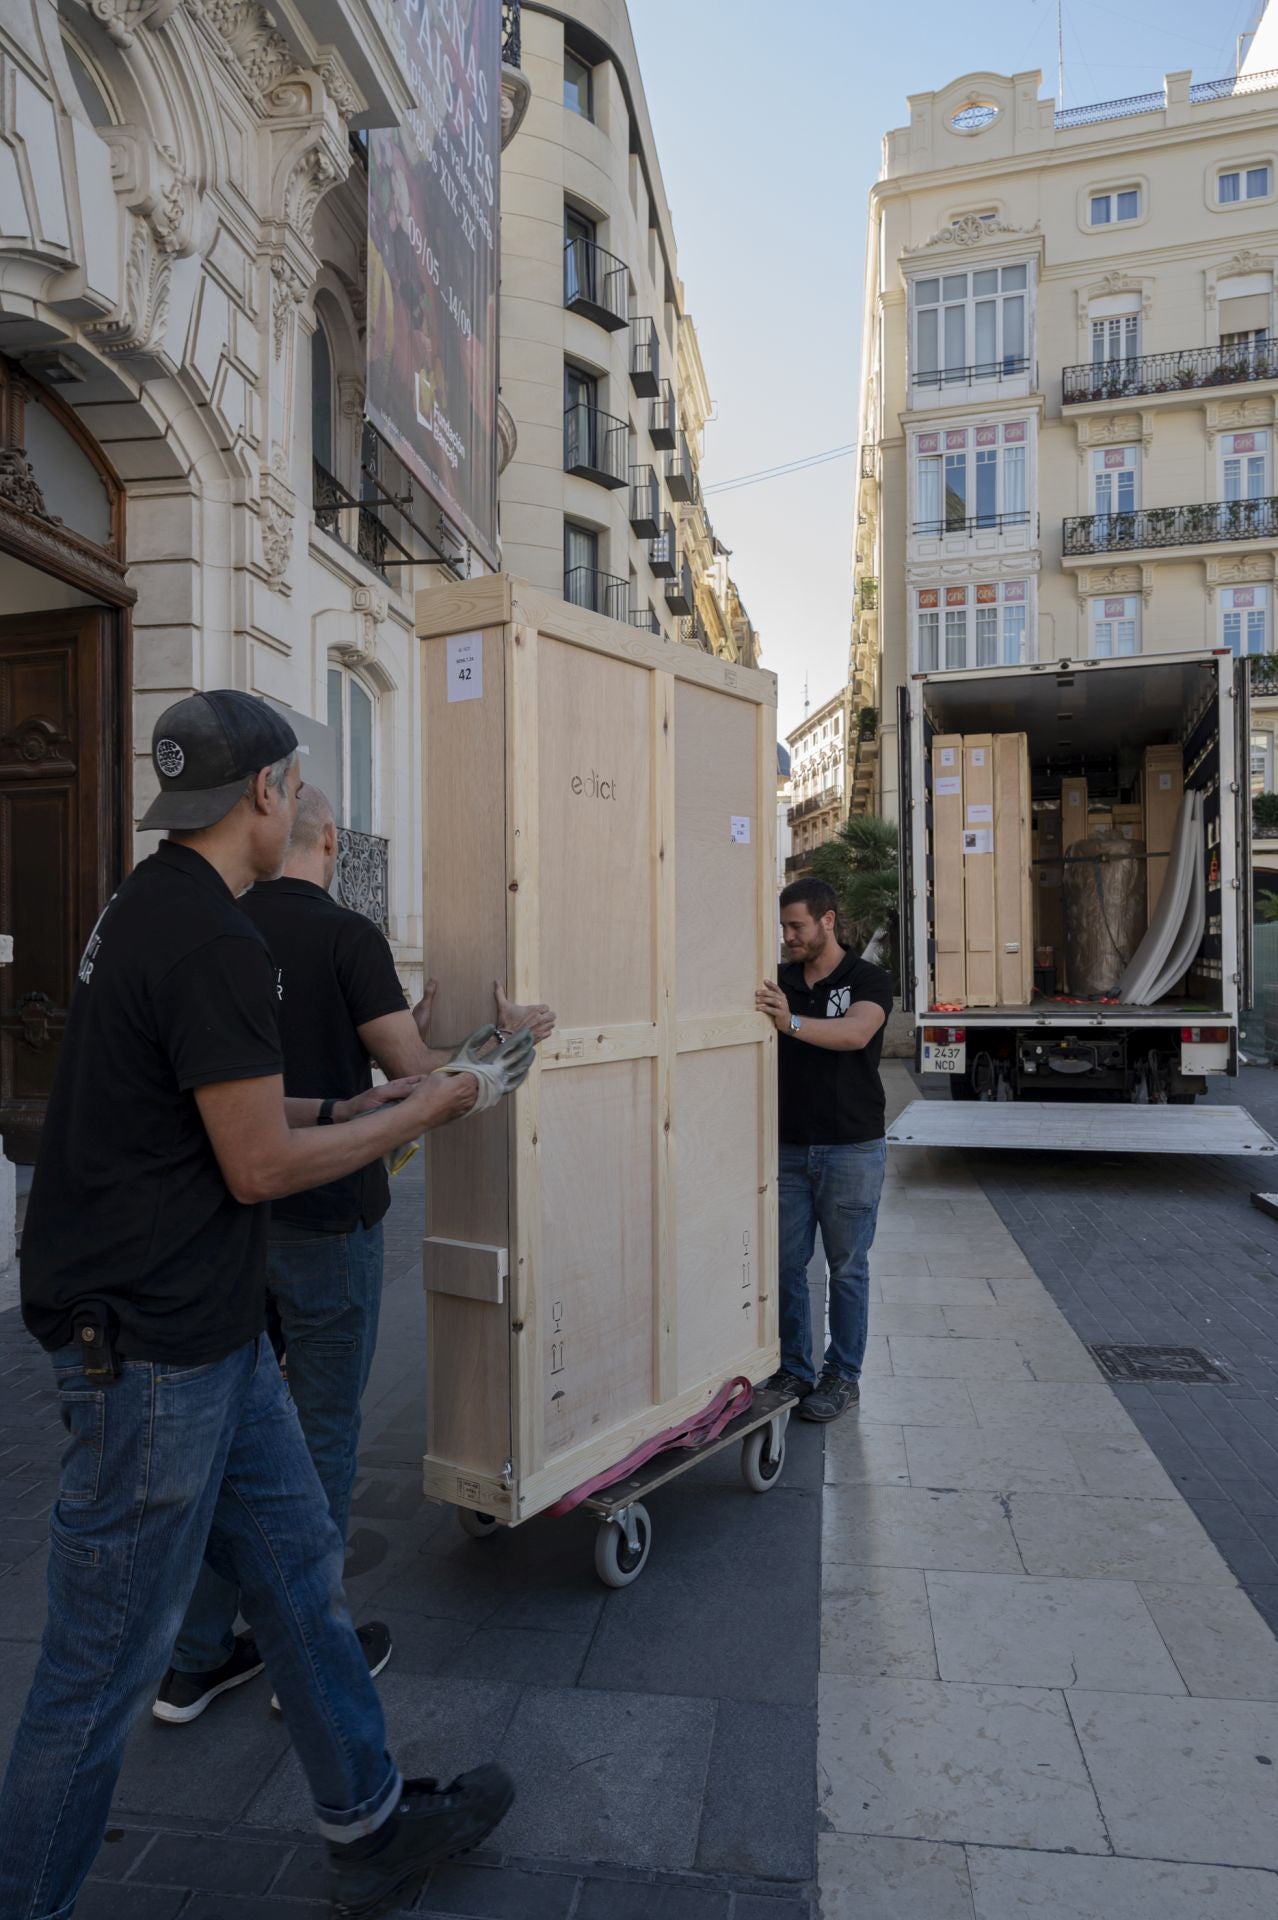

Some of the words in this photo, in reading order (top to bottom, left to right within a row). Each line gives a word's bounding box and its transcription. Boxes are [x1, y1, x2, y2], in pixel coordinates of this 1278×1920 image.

[408, 216, 439, 286] 09/05
[459, 668, 471, 680] 42
[571, 769, 617, 801] edict
[934, 1047, 960, 1059] 2437
[935, 1060, 955, 1070] NCD
